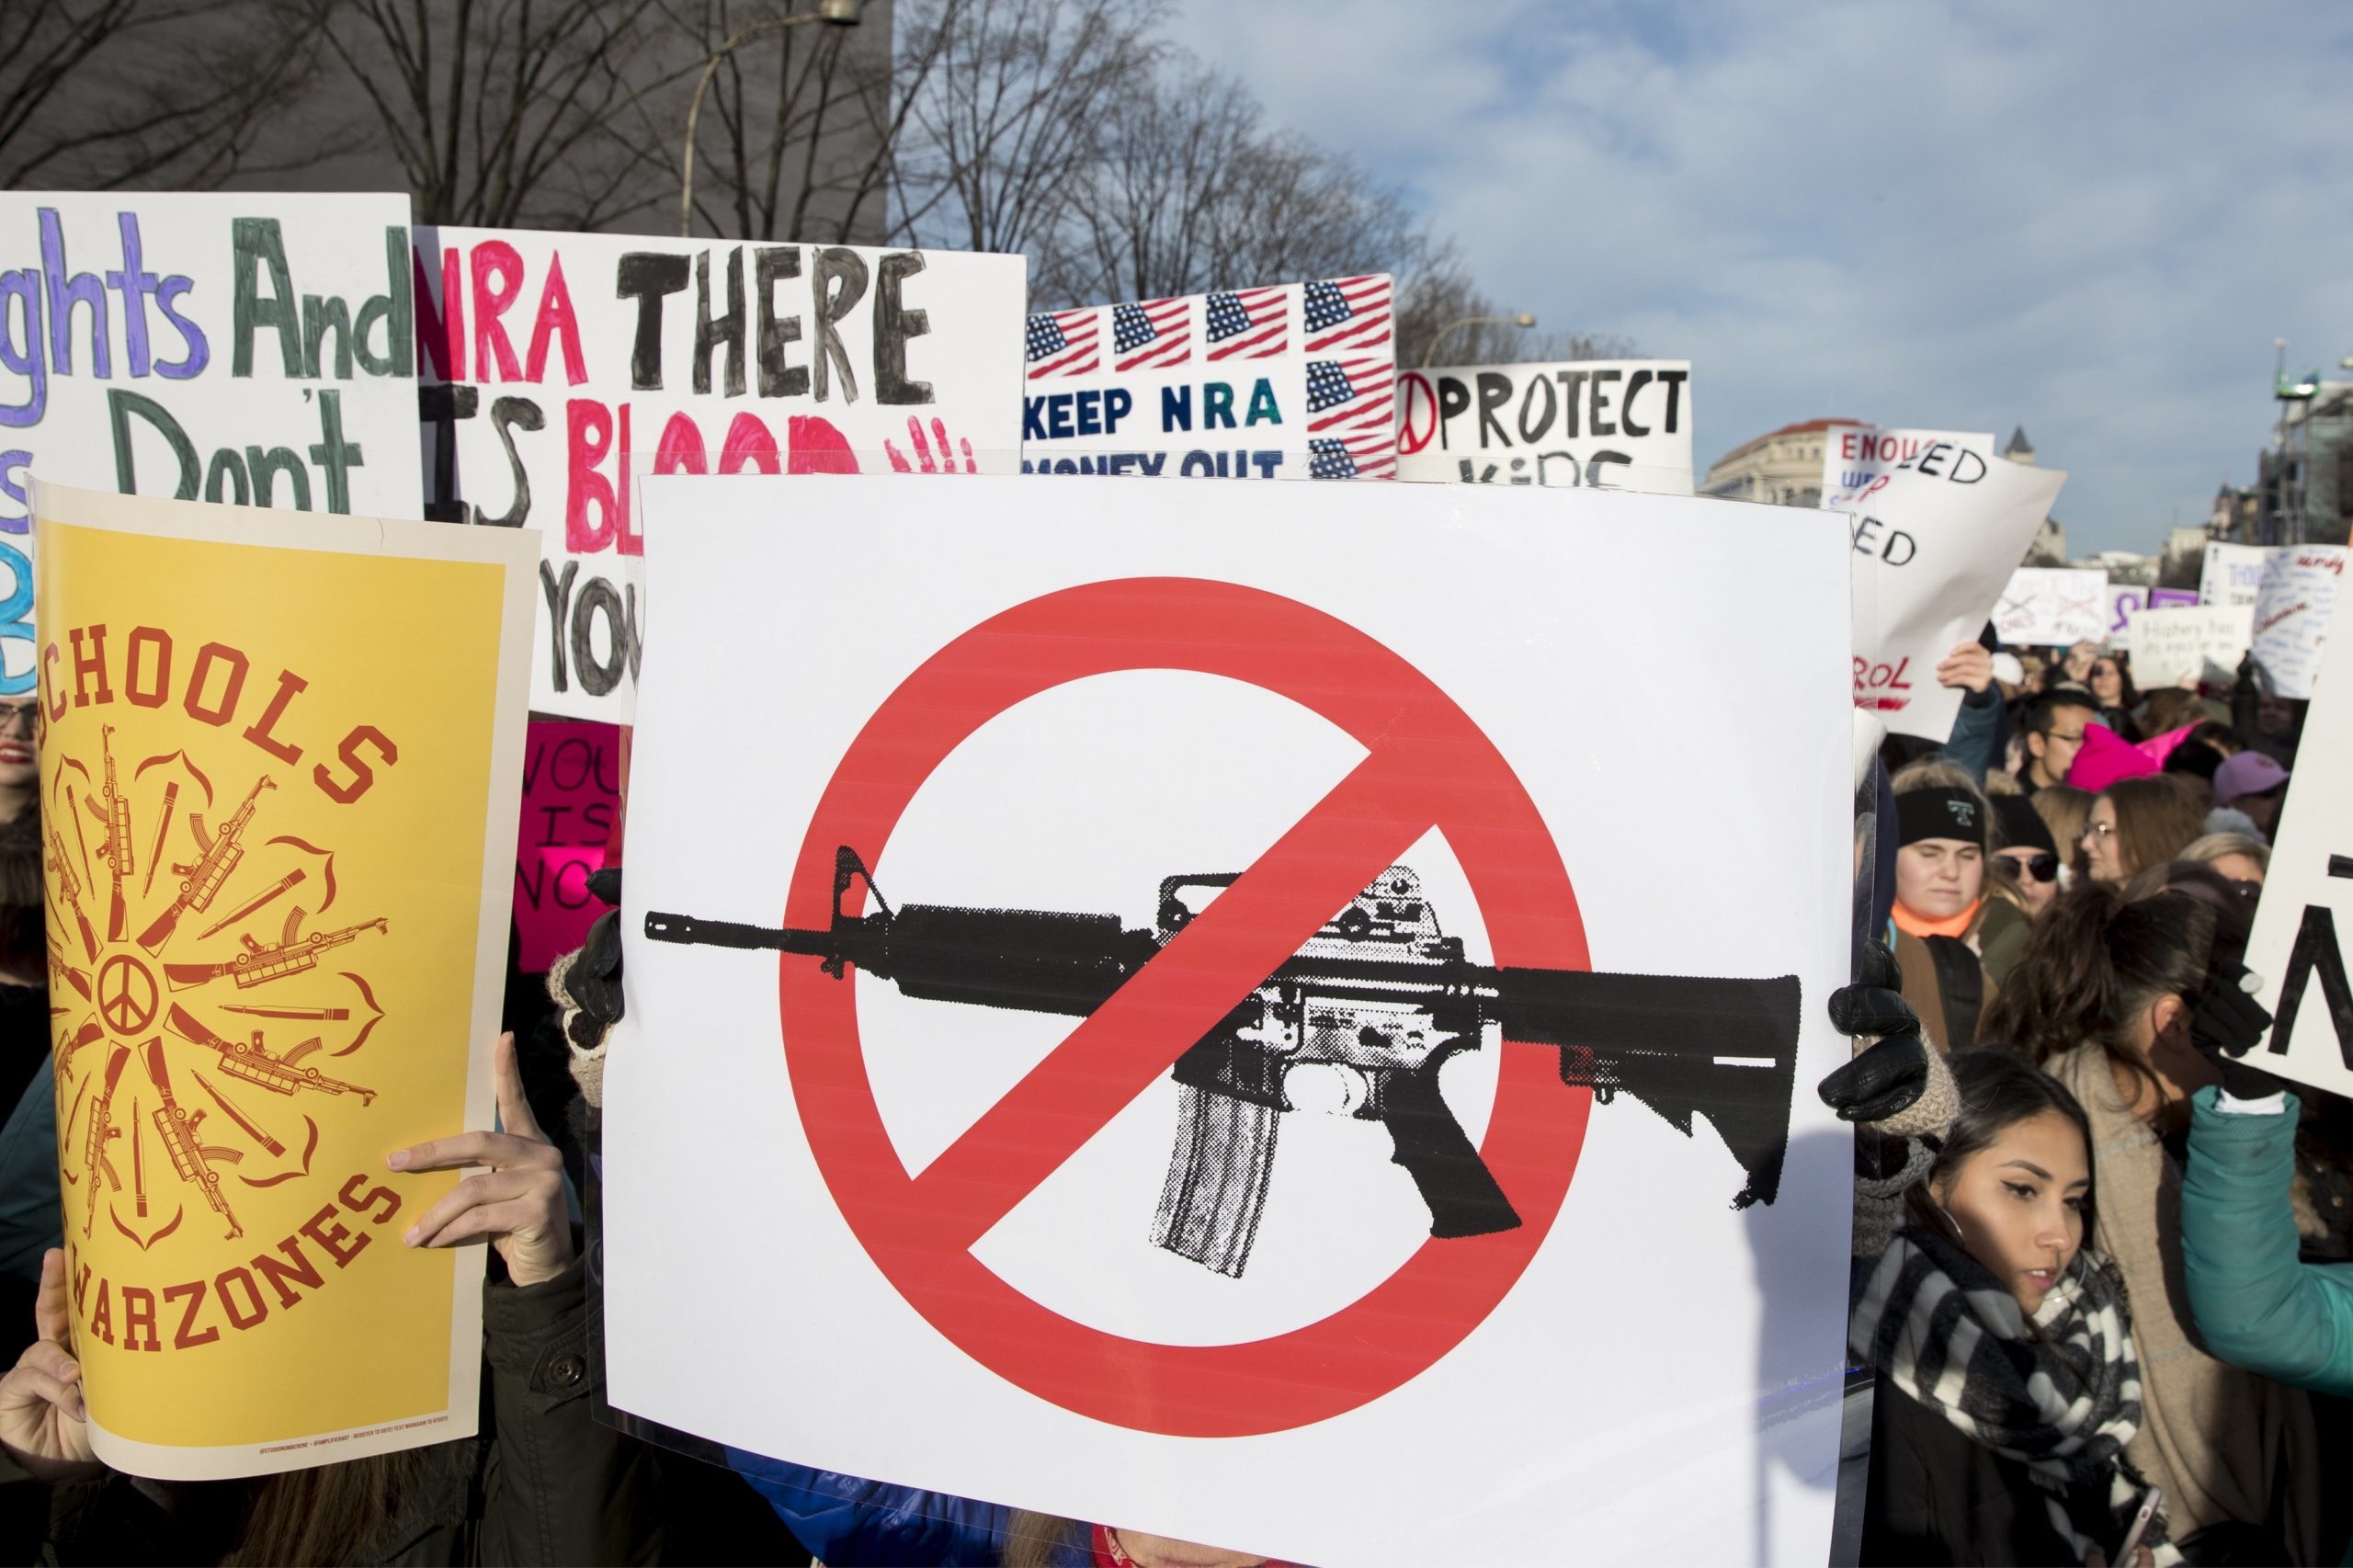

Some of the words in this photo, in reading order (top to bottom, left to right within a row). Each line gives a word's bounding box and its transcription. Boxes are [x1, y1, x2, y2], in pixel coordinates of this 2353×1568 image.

[232, 217, 414, 379] And
[414, 240, 589, 386] NRA
[617, 244, 936, 406] THERE
[1023, 388, 1131, 442] KEEP
[1161, 378, 1282, 433] NRA
[1439, 369, 1688, 449] PROTECT
[1841, 433, 1935, 462] ENOU
[535, 803, 613, 847] IS
[73, 1174, 402, 1352] WARZONES
